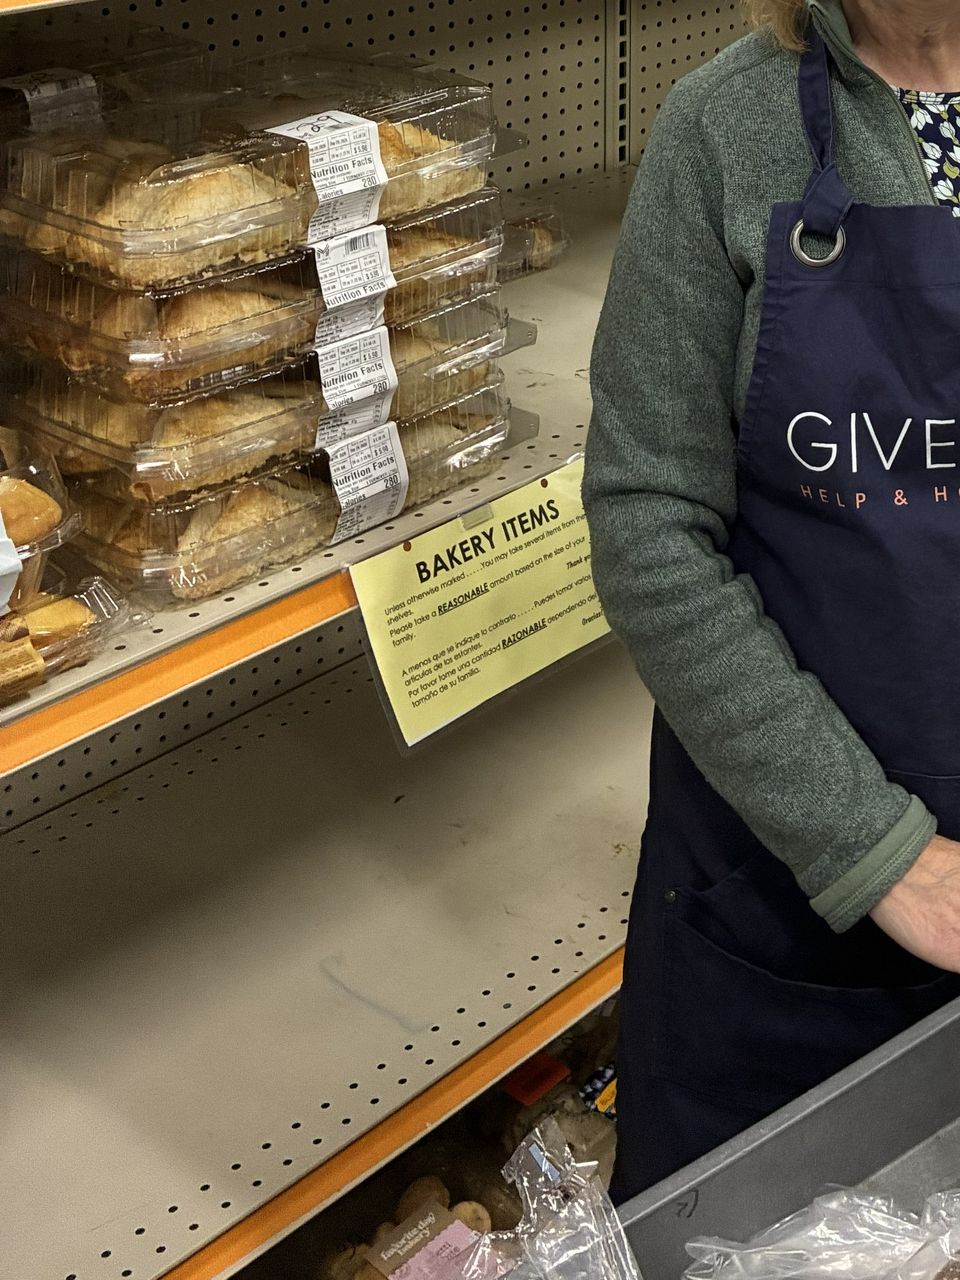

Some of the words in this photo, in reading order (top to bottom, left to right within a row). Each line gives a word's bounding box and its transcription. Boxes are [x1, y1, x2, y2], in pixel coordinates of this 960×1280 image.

[311, 162, 349, 179] Nutrition
[352, 155, 373, 169] Facts
[325, 289, 361, 306] Nutrition
[363, 281, 386, 294] Facts
[322, 371, 358, 388] Nutrition
[360, 362, 383, 375] Facts
[373, 381, 388, 393] 280
[333, 467, 371, 487] Nutrition
[372, 456, 395, 471] Facts
[384, 475, 399, 489] 280
[800, 484, 866, 509] HELP
[894, 489, 908, 506] &
[416, 527, 495, 584] BAKERY
[501, 499, 560, 542] ITEMS
[384, 601, 406, 616] Unless
[406, 586, 440, 606] otherwise
[440, 572, 466, 591] marked
[494, 552, 508, 563] may
[509, 544, 524, 556] take
[524, 532, 546, 547] several
[545, 525, 562, 537] items
[561, 518, 576, 530] from
[566, 556, 583, 569] Thank
[389, 623, 413, 637] Please
[414, 613, 430, 625] take
[431, 610, 437, 618] a
[437, 582, 490, 616] REASONABLE
[489, 571, 514, 589] amount
[514, 561, 535, 576] based
[535, 556, 543, 566] on
[543, 550, 553, 561] the
[554, 545, 565, 556] size
[566, 541, 572, 550] of
[572, 536, 586, 549] your
[386, 609, 414, 625] shelves.
[402, 669, 408, 677] A
[408, 657, 432, 674] menos
[432, 650, 446, 663] que
[446, 645, 455, 654] se
[455, 632, 480, 649] indique
[480, 628, 487, 637] lo
[488, 613, 516, 633] contrario
[556, 582, 573, 596] tomar
[574, 574, 592, 586] varios
[392, 632, 416, 647] family.
[408, 689, 419, 698] Por
[420, 677, 438, 692] favor
[438, 668, 457, 681] tome
[457, 661, 471, 672] una
[471, 643, 501, 664] cantidad
[501, 617, 547, 650] RAZONABLE
[547, 597, 587, 624] dependiendo
[587, 591, 597, 602] del
[433, 661, 443, 672] de
[443, 657, 453, 666] los
[454, 642, 482, 661] estantes.
[411, 689, 439, 708] tamaño
[439, 684, 449, 693] de
[449, 680, 457, 688] su
[457, 667, 481, 683] familia.
